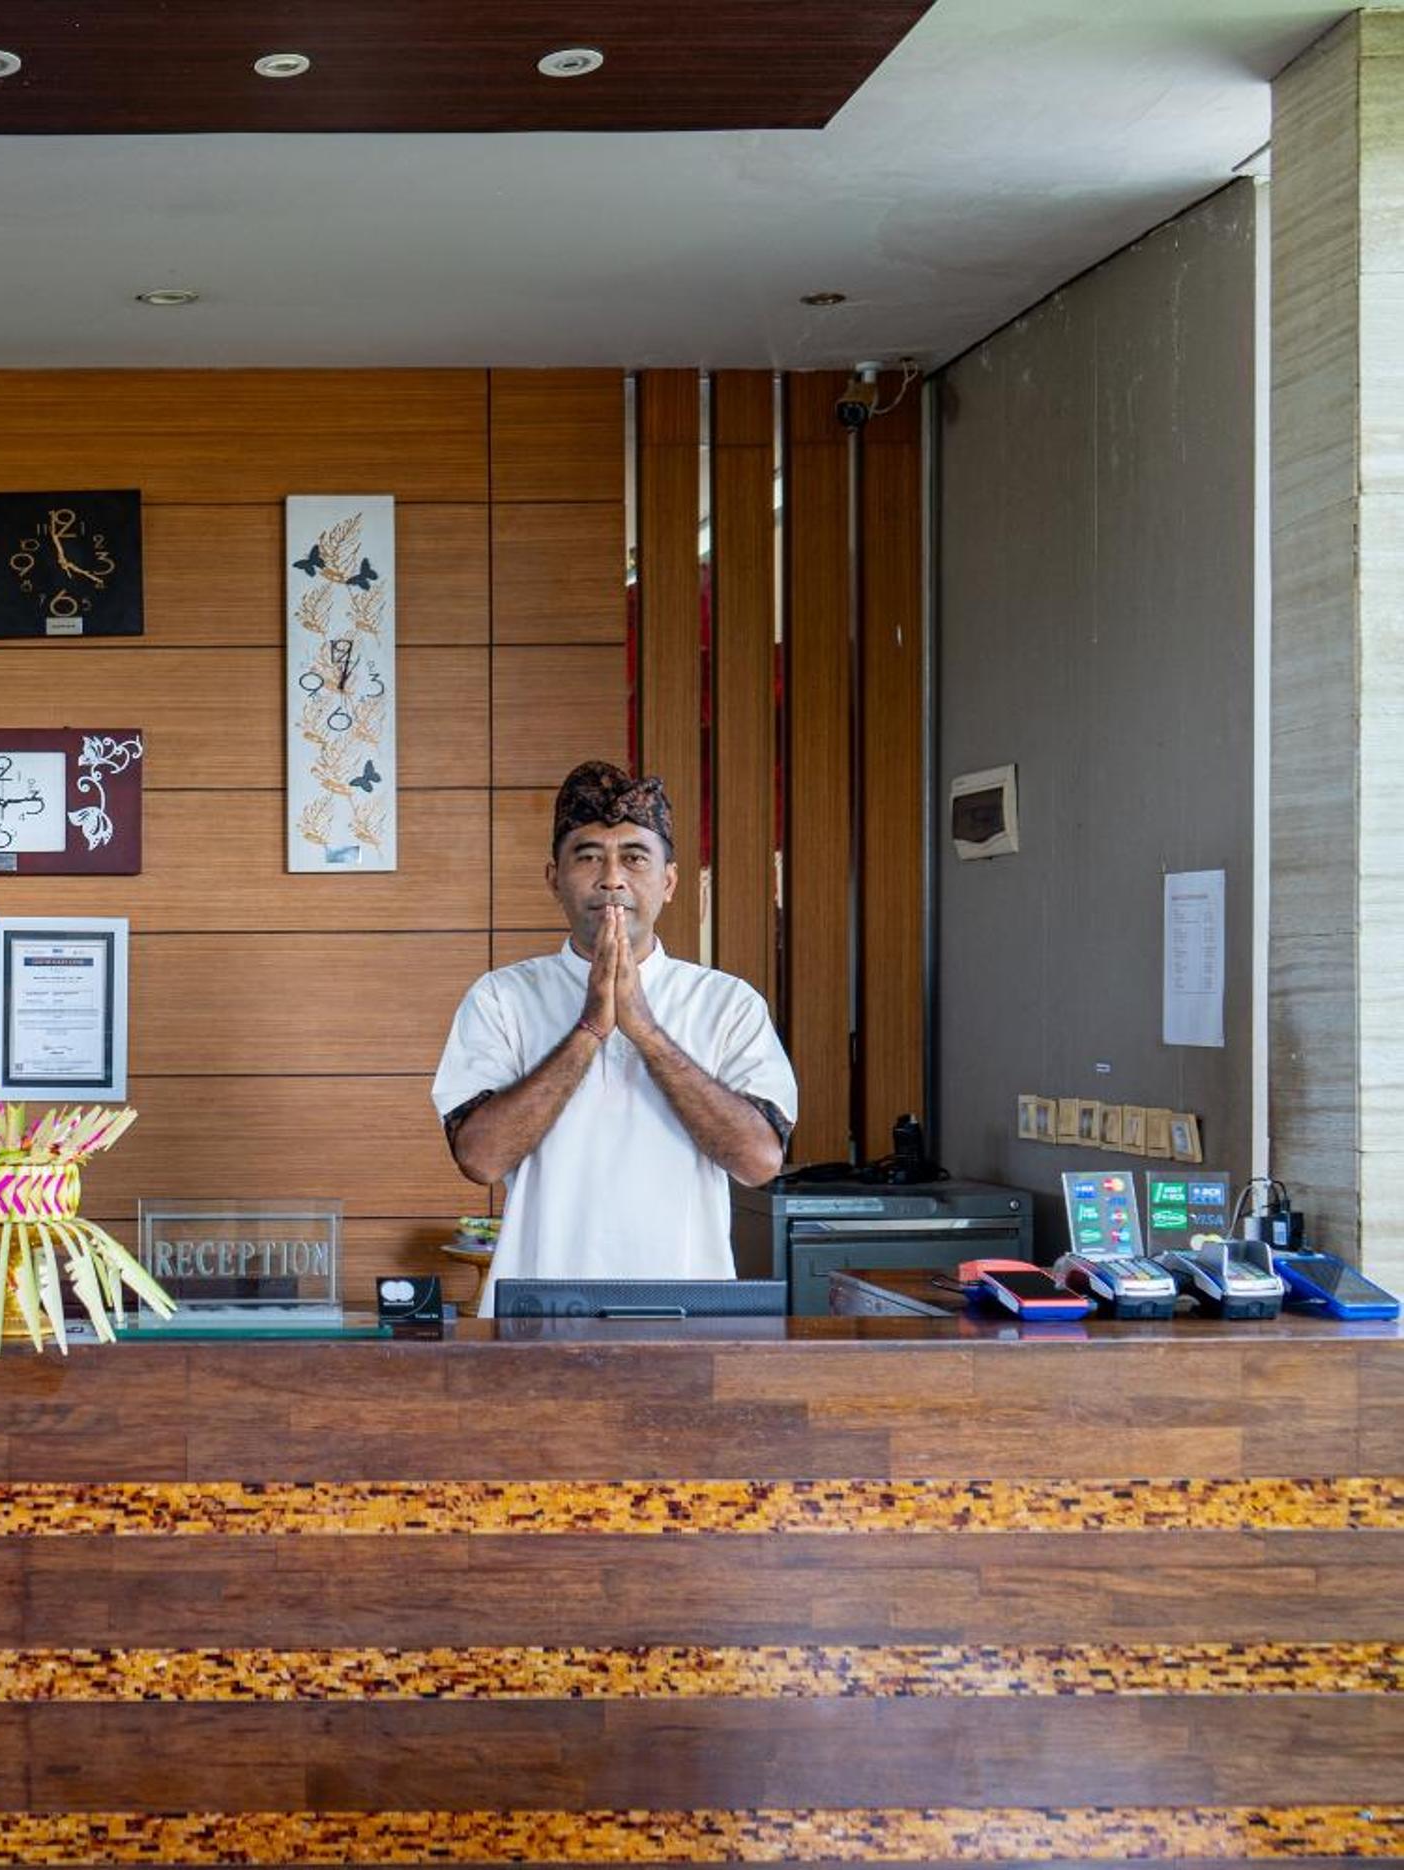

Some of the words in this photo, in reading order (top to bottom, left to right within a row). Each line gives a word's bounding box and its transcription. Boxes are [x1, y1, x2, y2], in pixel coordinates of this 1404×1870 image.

[49, 509, 77, 538] 12
[10, 553, 35, 577] 9
[93, 551, 115, 575] 3
[50, 589, 78, 617] 6
[299, 672, 325, 697] 9
[365, 673, 384, 697] 3
[327, 706, 352, 731] 6
[154, 1240, 329, 1278] RECEPTION
